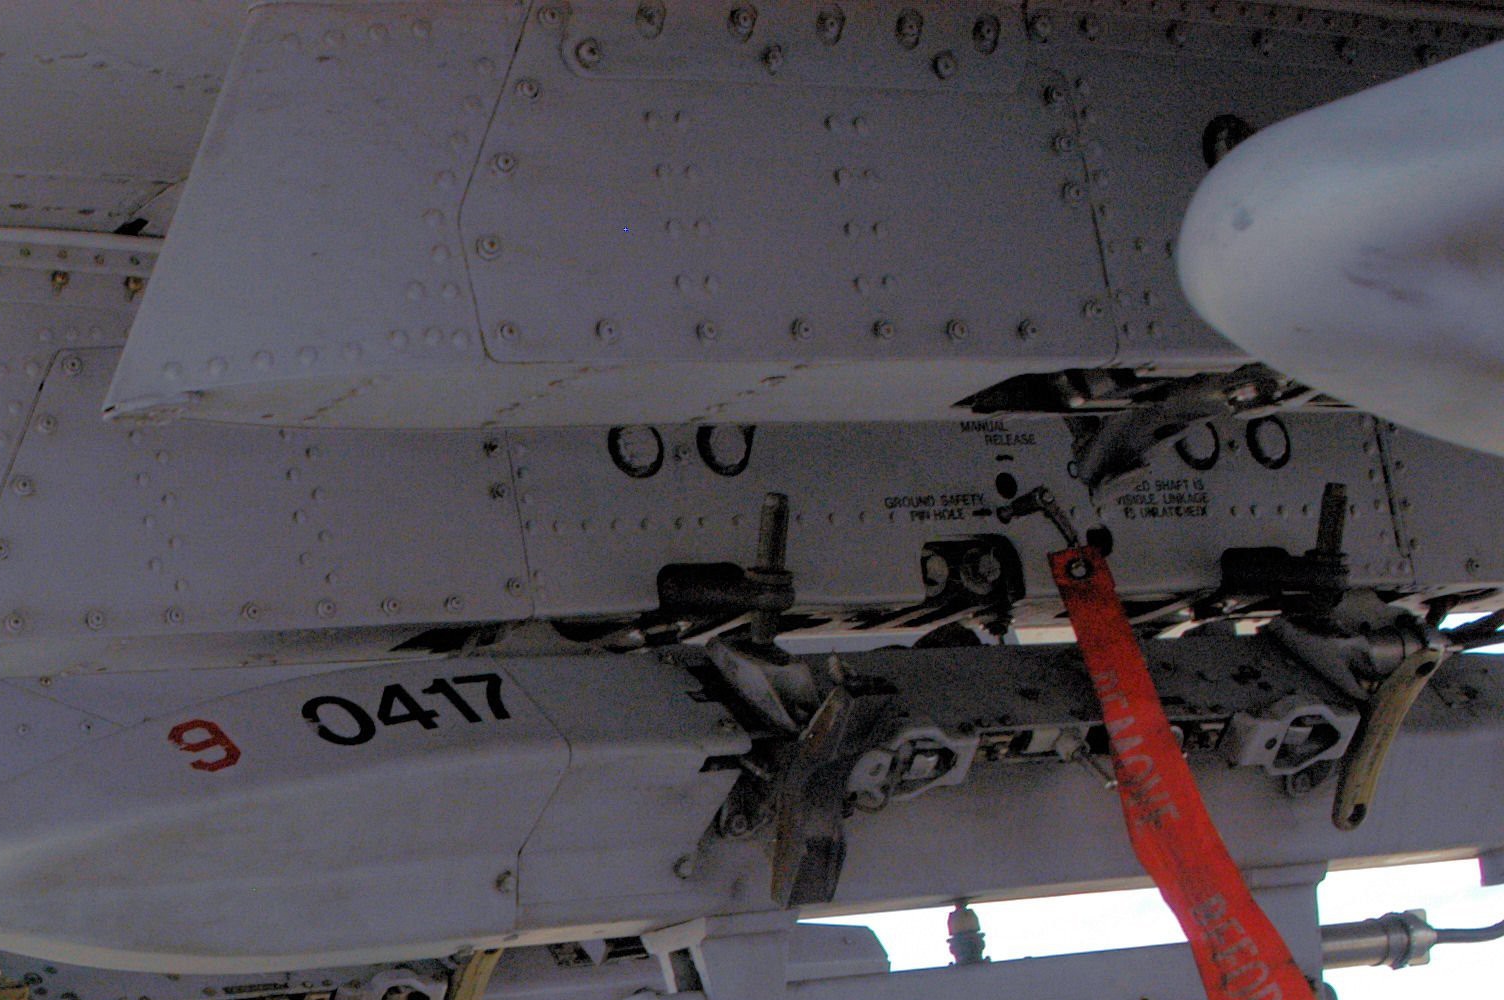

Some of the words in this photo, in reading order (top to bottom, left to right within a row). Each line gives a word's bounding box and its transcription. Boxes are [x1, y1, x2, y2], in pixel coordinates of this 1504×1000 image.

[960, 420, 1008, 432] MANUAL
[985, 434, 1036, 446] RELEASE
[884, 495, 935, 509] GROUND
[940, 493, 985, 506] SAFETY
[168, 719, 241, 772] 9
[302, 673, 511, 746] 0417
